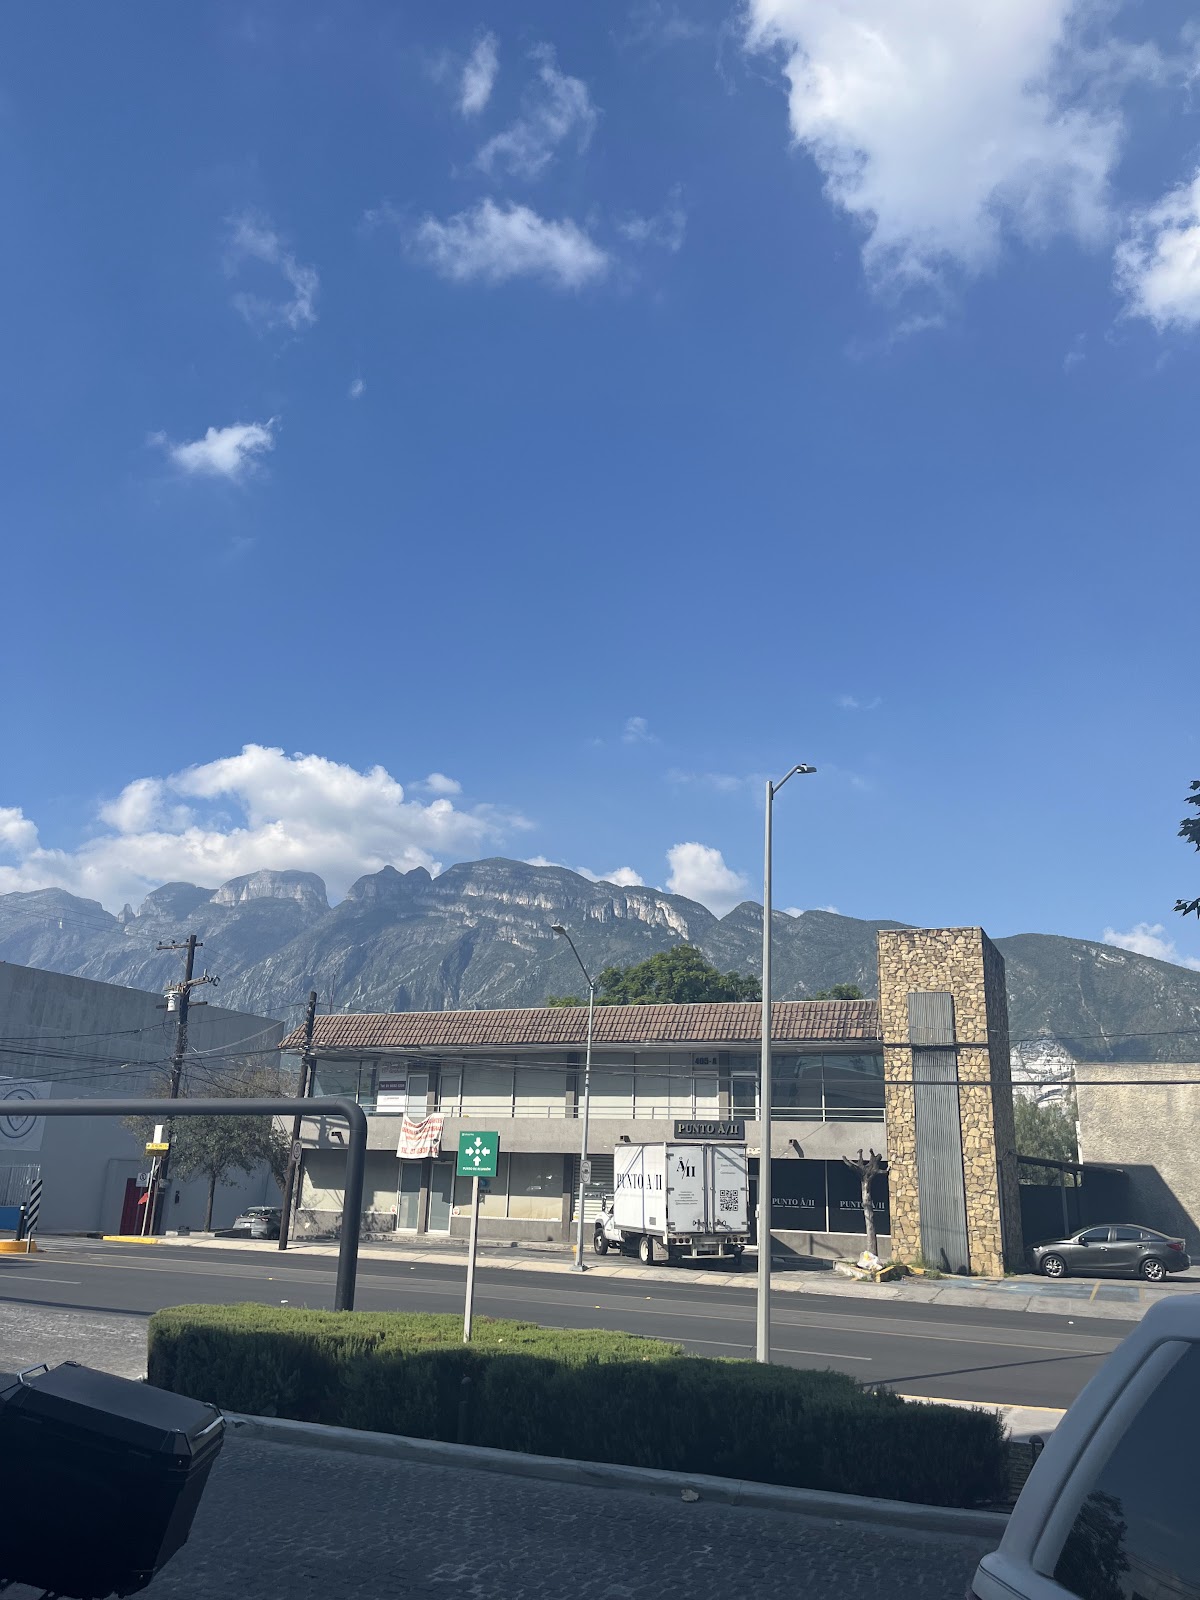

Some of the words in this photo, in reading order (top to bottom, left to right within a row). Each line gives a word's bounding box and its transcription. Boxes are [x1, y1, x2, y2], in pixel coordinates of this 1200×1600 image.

[678, 1123, 715, 1133] PUNTO
[617, 1173, 644, 1189] PUNTO
[772, 1197, 798, 1205] PUNTO
